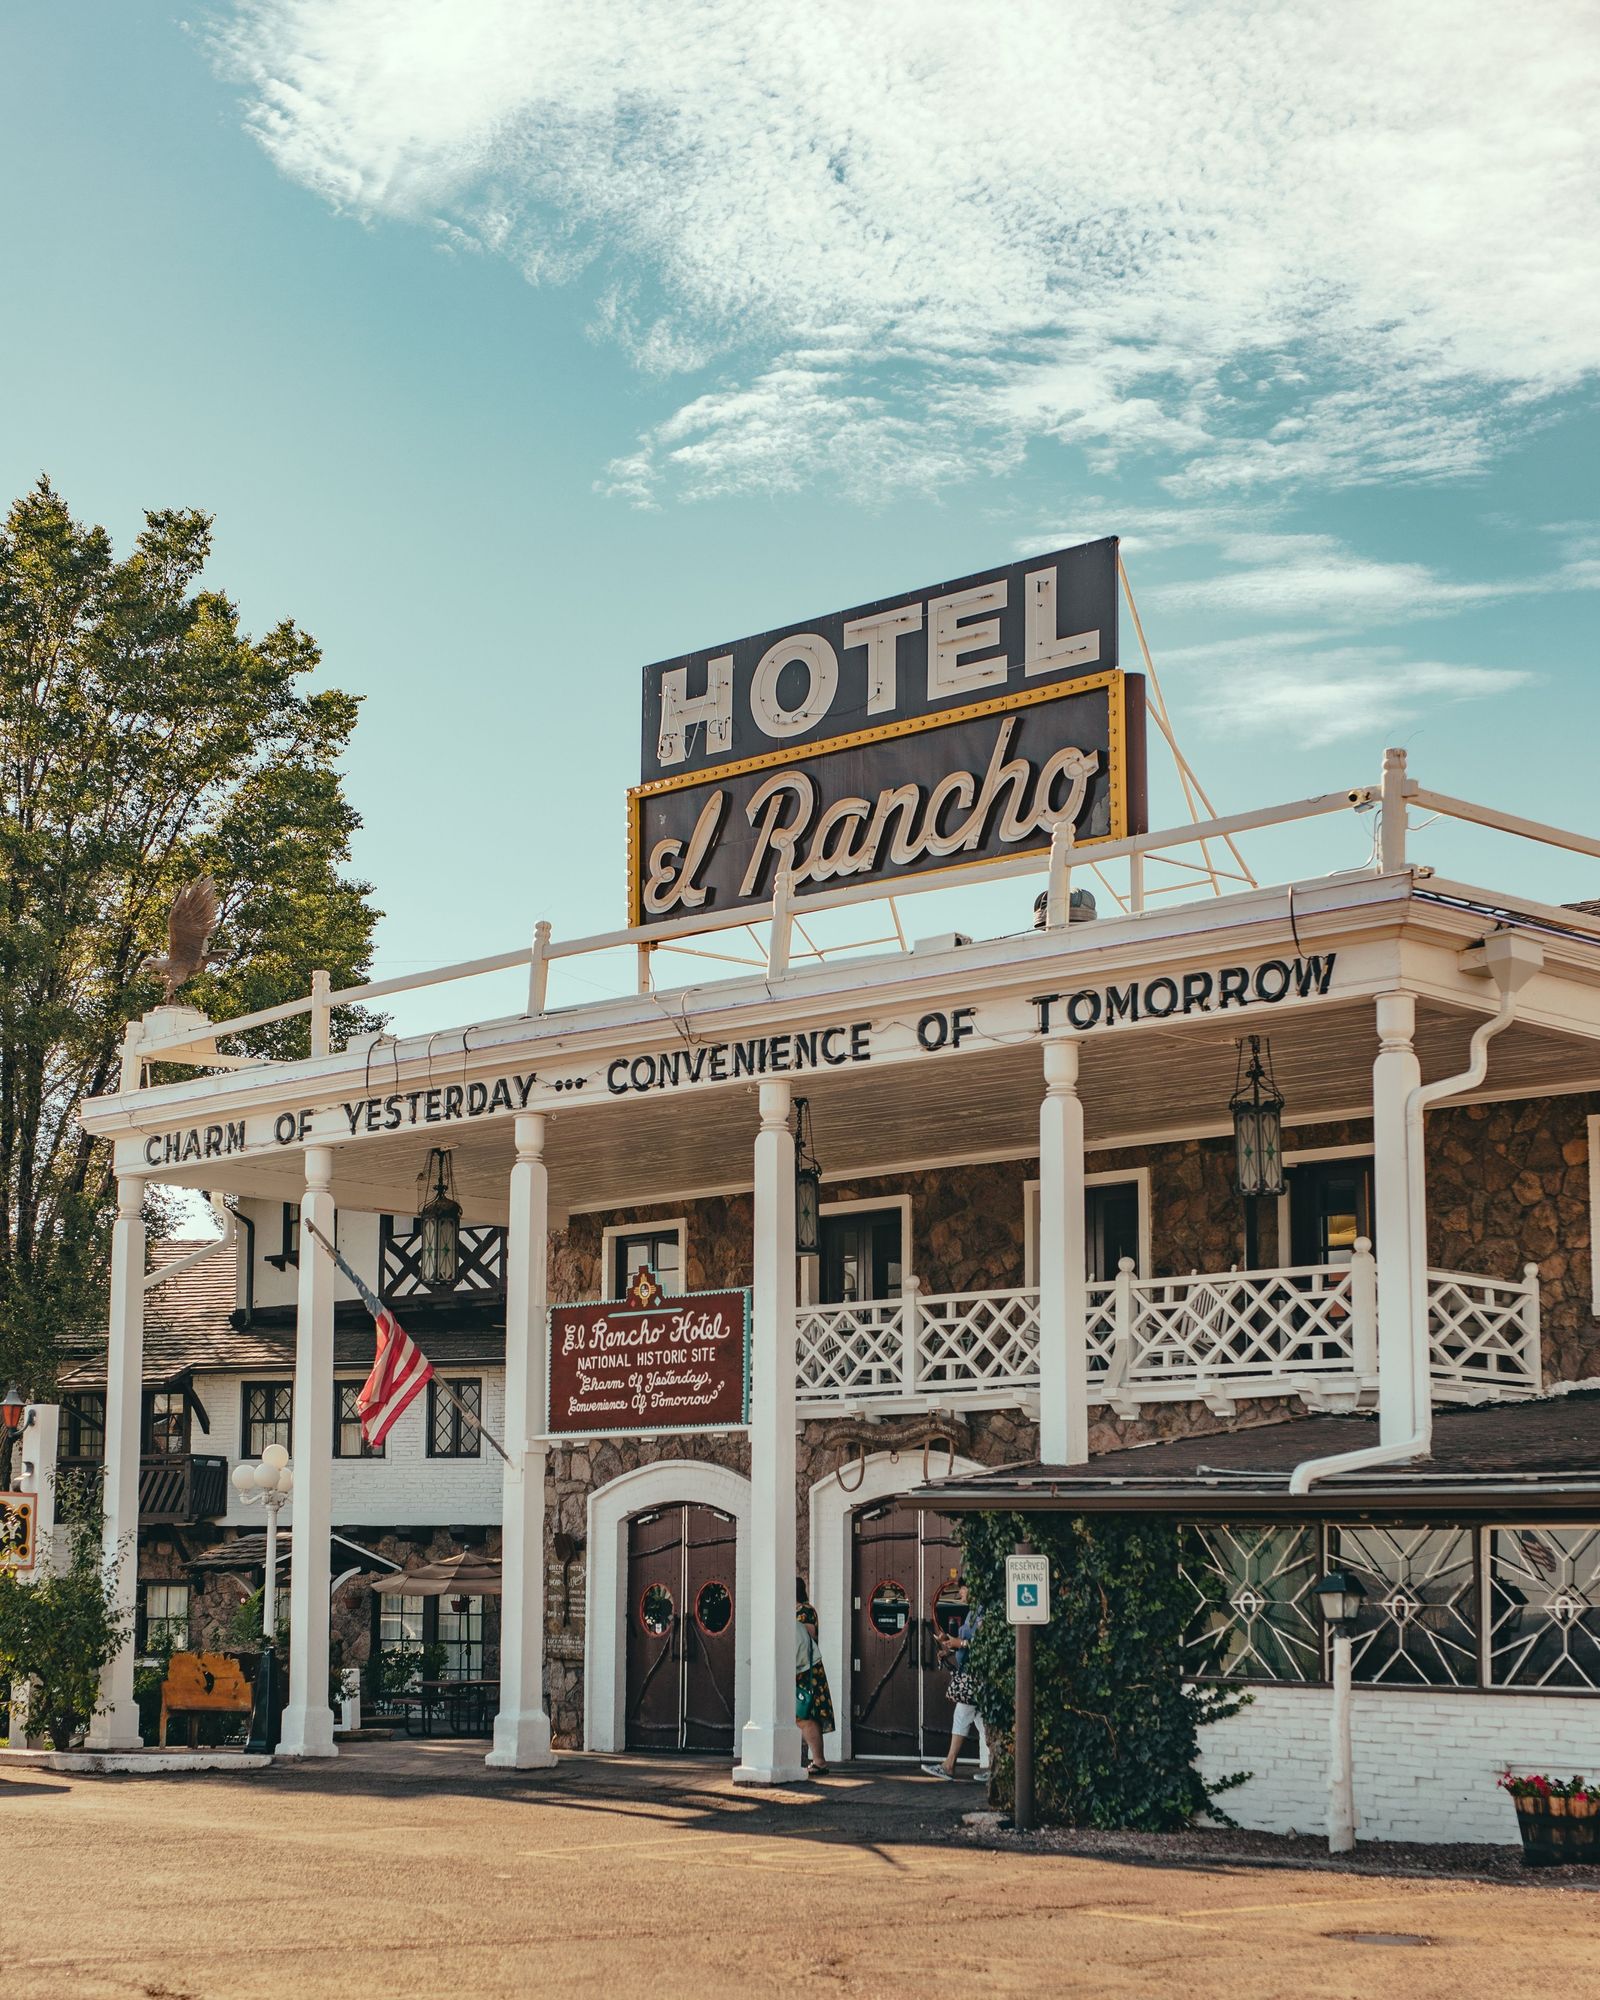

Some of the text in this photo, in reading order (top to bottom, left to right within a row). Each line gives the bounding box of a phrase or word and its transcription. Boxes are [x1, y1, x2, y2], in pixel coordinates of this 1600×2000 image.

[660, 566, 1100, 767] HOTEL
[738, 717, 1098, 896] Rancho
[143, 1120, 247, 1166] CHARM
[274, 1109, 314, 1145] OF
[343, 1072, 537, 1135] YESTERDAY
[607, 1022, 872, 1094] CONVENIENCE
[917, 1007, 976, 1050] OF
[1030, 953, 1336, 1034] TOMORROW
[562, 1310, 730, 1355] El Rancho Hotel
[577, 1346, 716, 1371] NATIONAL HISTORIC SITE
[628, 1372, 643, 1393] Of
[645, 1368, 712, 1393] Yesterday,
[568, 1396, 628, 1416] Convenience
[631, 1393, 648, 1415] Of
[1009, 1561, 1045, 1571] RESERVED
[1012, 1573, 1043, 1582] PARKING
